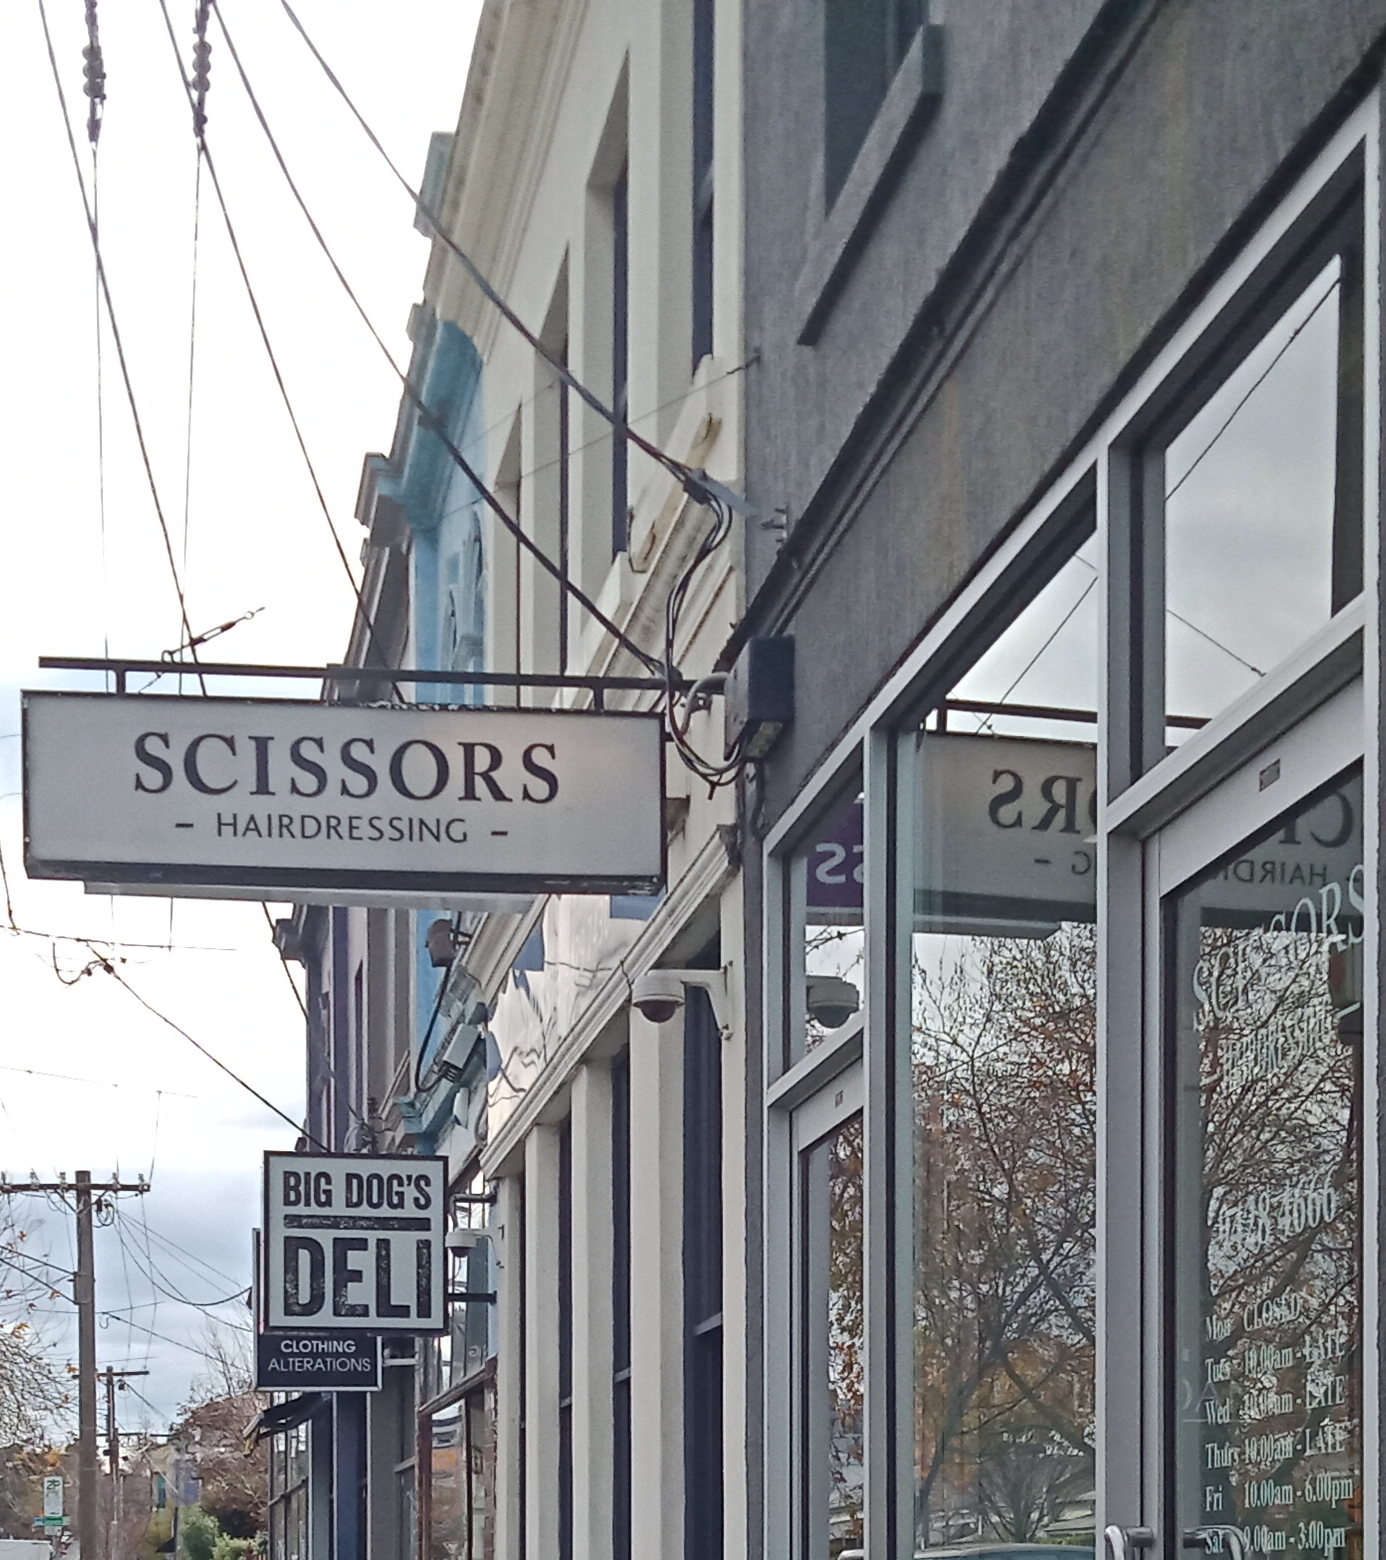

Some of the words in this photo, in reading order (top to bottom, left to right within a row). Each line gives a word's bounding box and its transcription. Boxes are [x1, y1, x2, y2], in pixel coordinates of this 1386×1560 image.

[133, 731, 559, 804] SCISSORS
[217, 812, 468, 844] HAIRDRESSING
[1193, 864, 1363, 1021] SCIORS
[283, 1171, 332, 1208] BIG
[345, 1172, 432, 1210] DOG'S
[283, 1236, 432, 1319] DELI
[1205, 1315, 1232, 1342] Mon
[1243, 1291, 1301, 1331] CLOSED
[267, 1358, 371, 1372] ALTERATIONS
[280, 1340, 356, 1353] CLOTHING
[1205, 1357, 1231, 1383] Tues
[1244, 1345, 1293, 1376] 10.00am
[1303, 1327, 1345, 1363] LATE
[1205, 1398, 1231, 1426] Wed
[1305, 1375, 1346, 1410] LATE
[1205, 1441, 1240, 1470] Thurs
[1244, 1433, 1293, 1463] 10.00am
[1304, 1422, 1346, 1457] LATE
[1205, 1484, 1223, 1511] Fri
[1244, 1478, 1293, 1508] 10.00am
[1304, 1473, 1354, 1508] 6.00pm
[1205, 1528, 1225, 1554] Sat
[1244, 1525, 1286, 1553] 9.00am
[1297, 1520, 1346, 1556] 3.00pm
